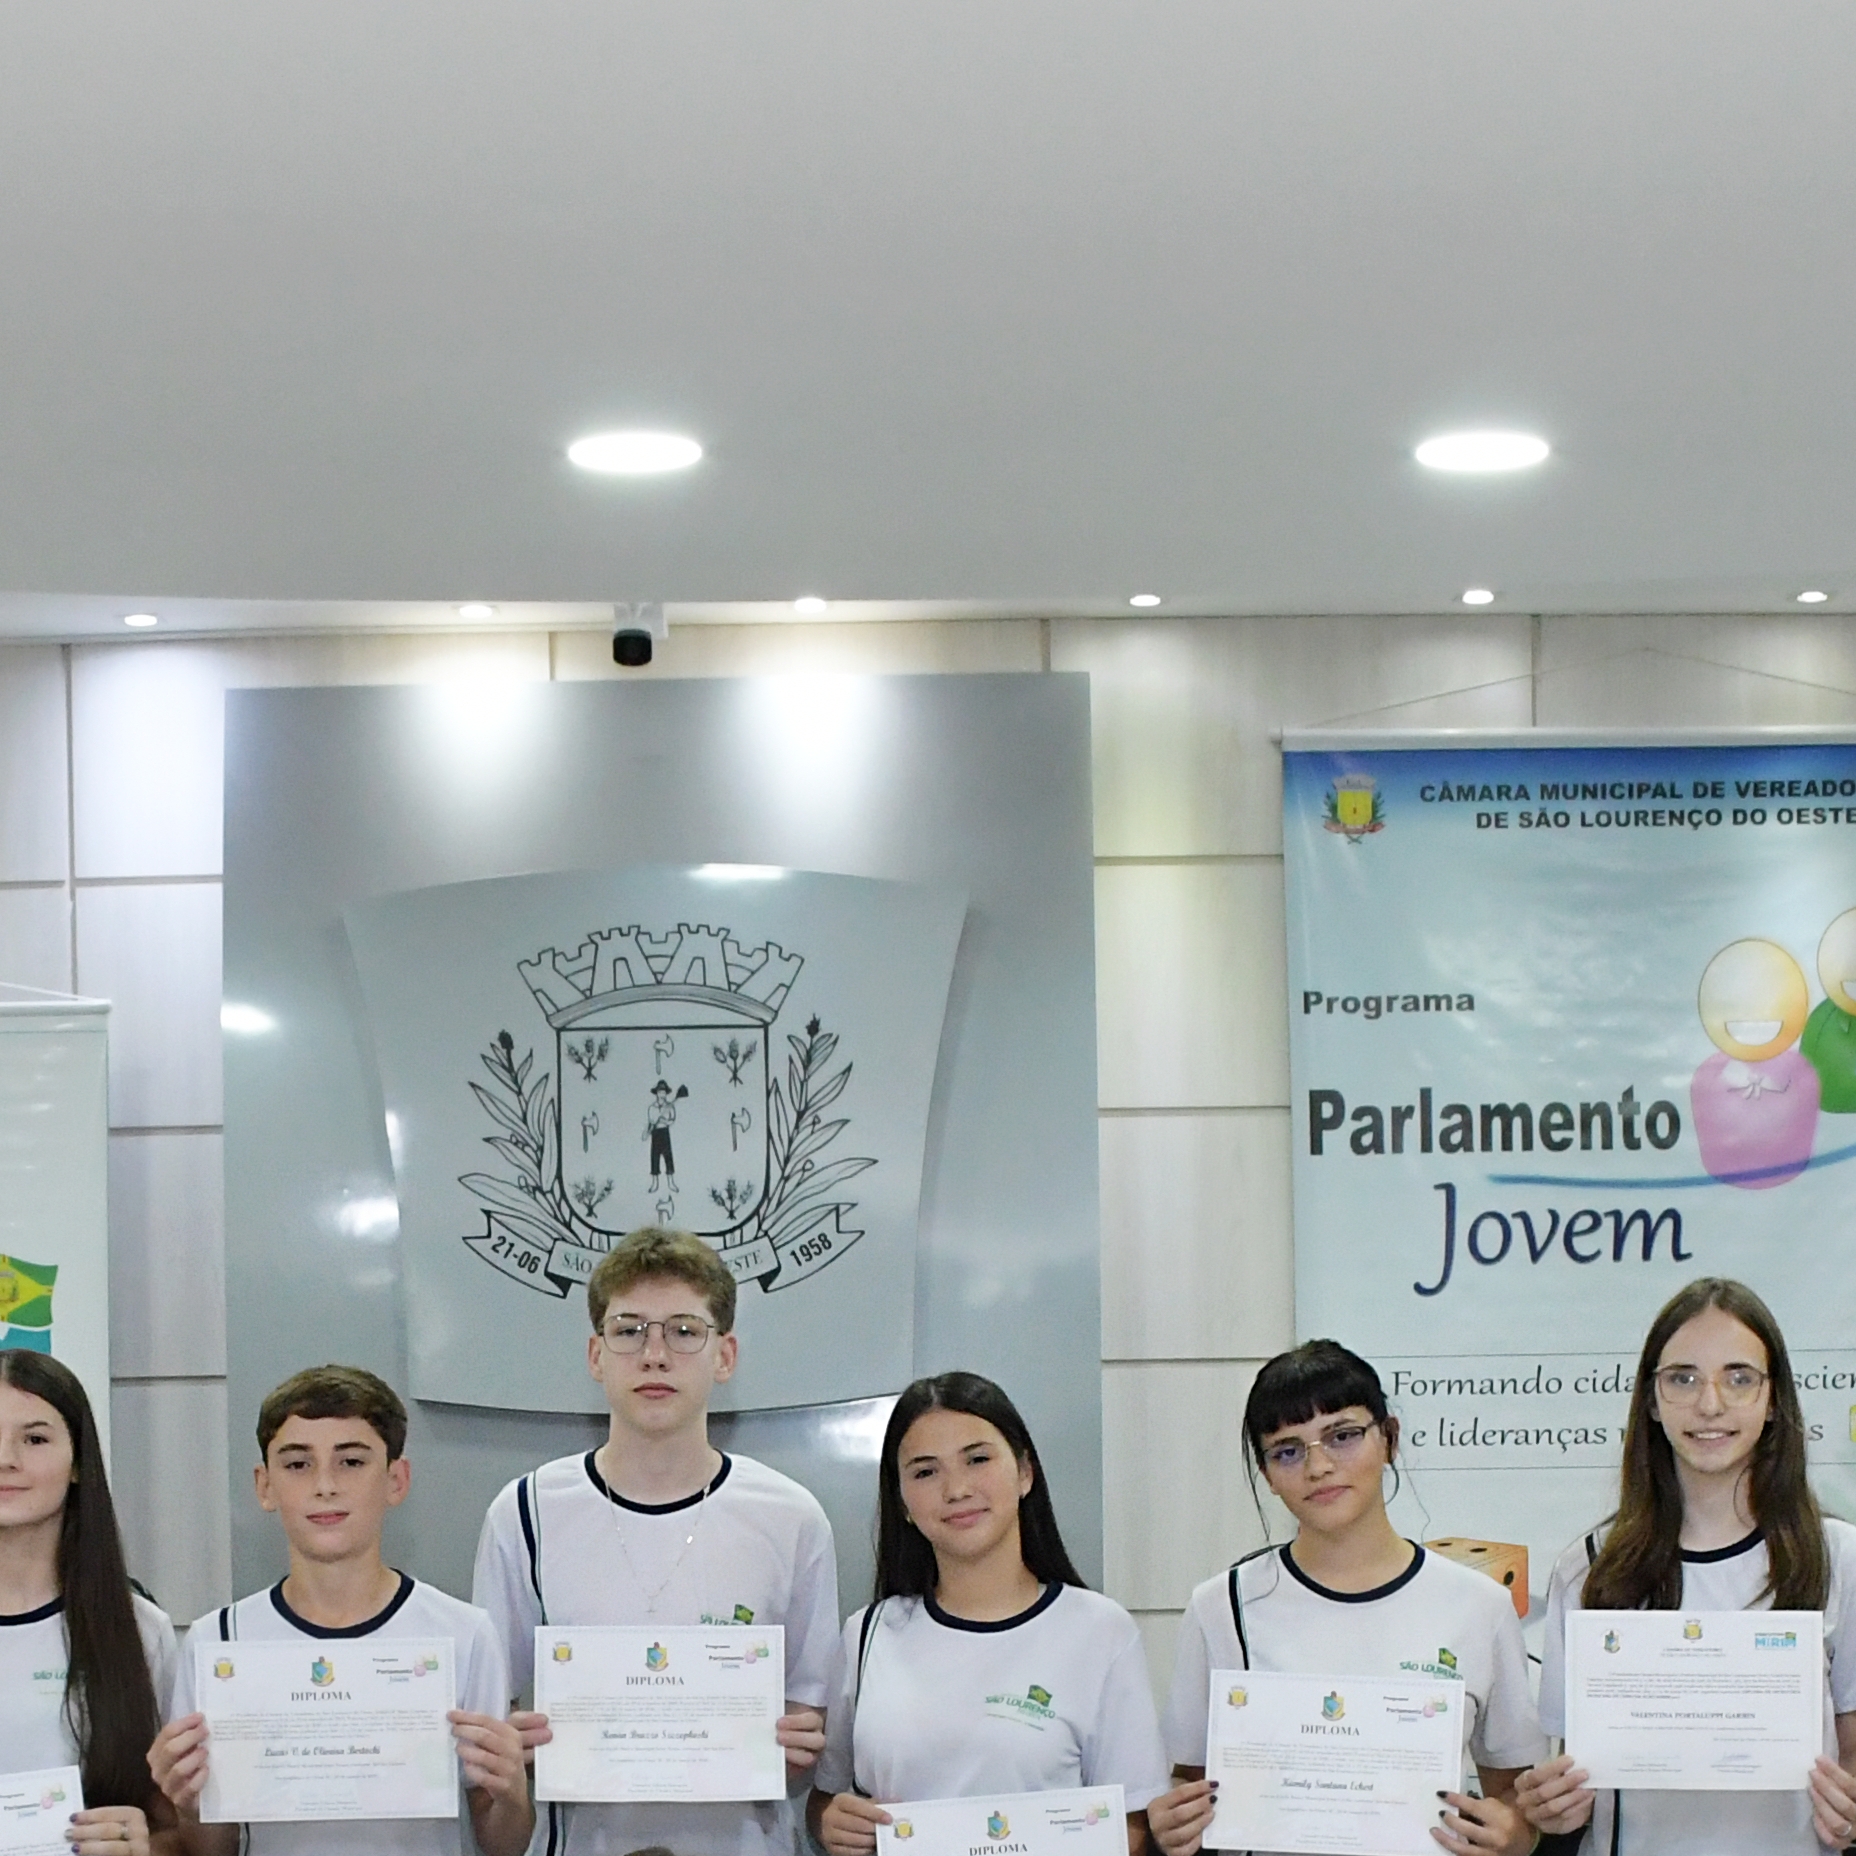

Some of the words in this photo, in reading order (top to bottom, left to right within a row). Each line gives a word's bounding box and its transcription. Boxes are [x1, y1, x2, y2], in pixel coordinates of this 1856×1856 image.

[1420, 781, 1530, 803] CÂMARA
[1540, 780, 1684, 801] MUNICIPAL
[1693, 781, 1726, 800] DE
[1476, 812, 1509, 830] DE
[1518, 805, 1571, 830] SÃO
[1580, 808, 1723, 831] LOURENÇO
[1732, 807, 1768, 826] DO
[1303, 990, 1475, 1020] Programa
[1308, 1084, 1682, 1156] Parlamento
[789, 1232, 833, 1268] 1958
[1412, 1181, 1693, 1297] Jovem
[490, 1235, 541, 1274] 21-06
[562, 1251, 592, 1274] SÃO
[1391, 1366, 1563, 1398] Formando
[1411, 1424, 1427, 1447] e
[1438, 1418, 1607, 1454] lideranças
[1400, 1661, 1418, 1671] SÃO
[626, 1676, 685, 1686] DIPLOMA
[291, 1691, 352, 1702] DIPLOMA
[1006, 1697, 1056, 1719] LOURENÇO
[1300, 1724, 1360, 1736] DIPLOMA
[969, 1843, 1028, 1856] DIPLOMA
